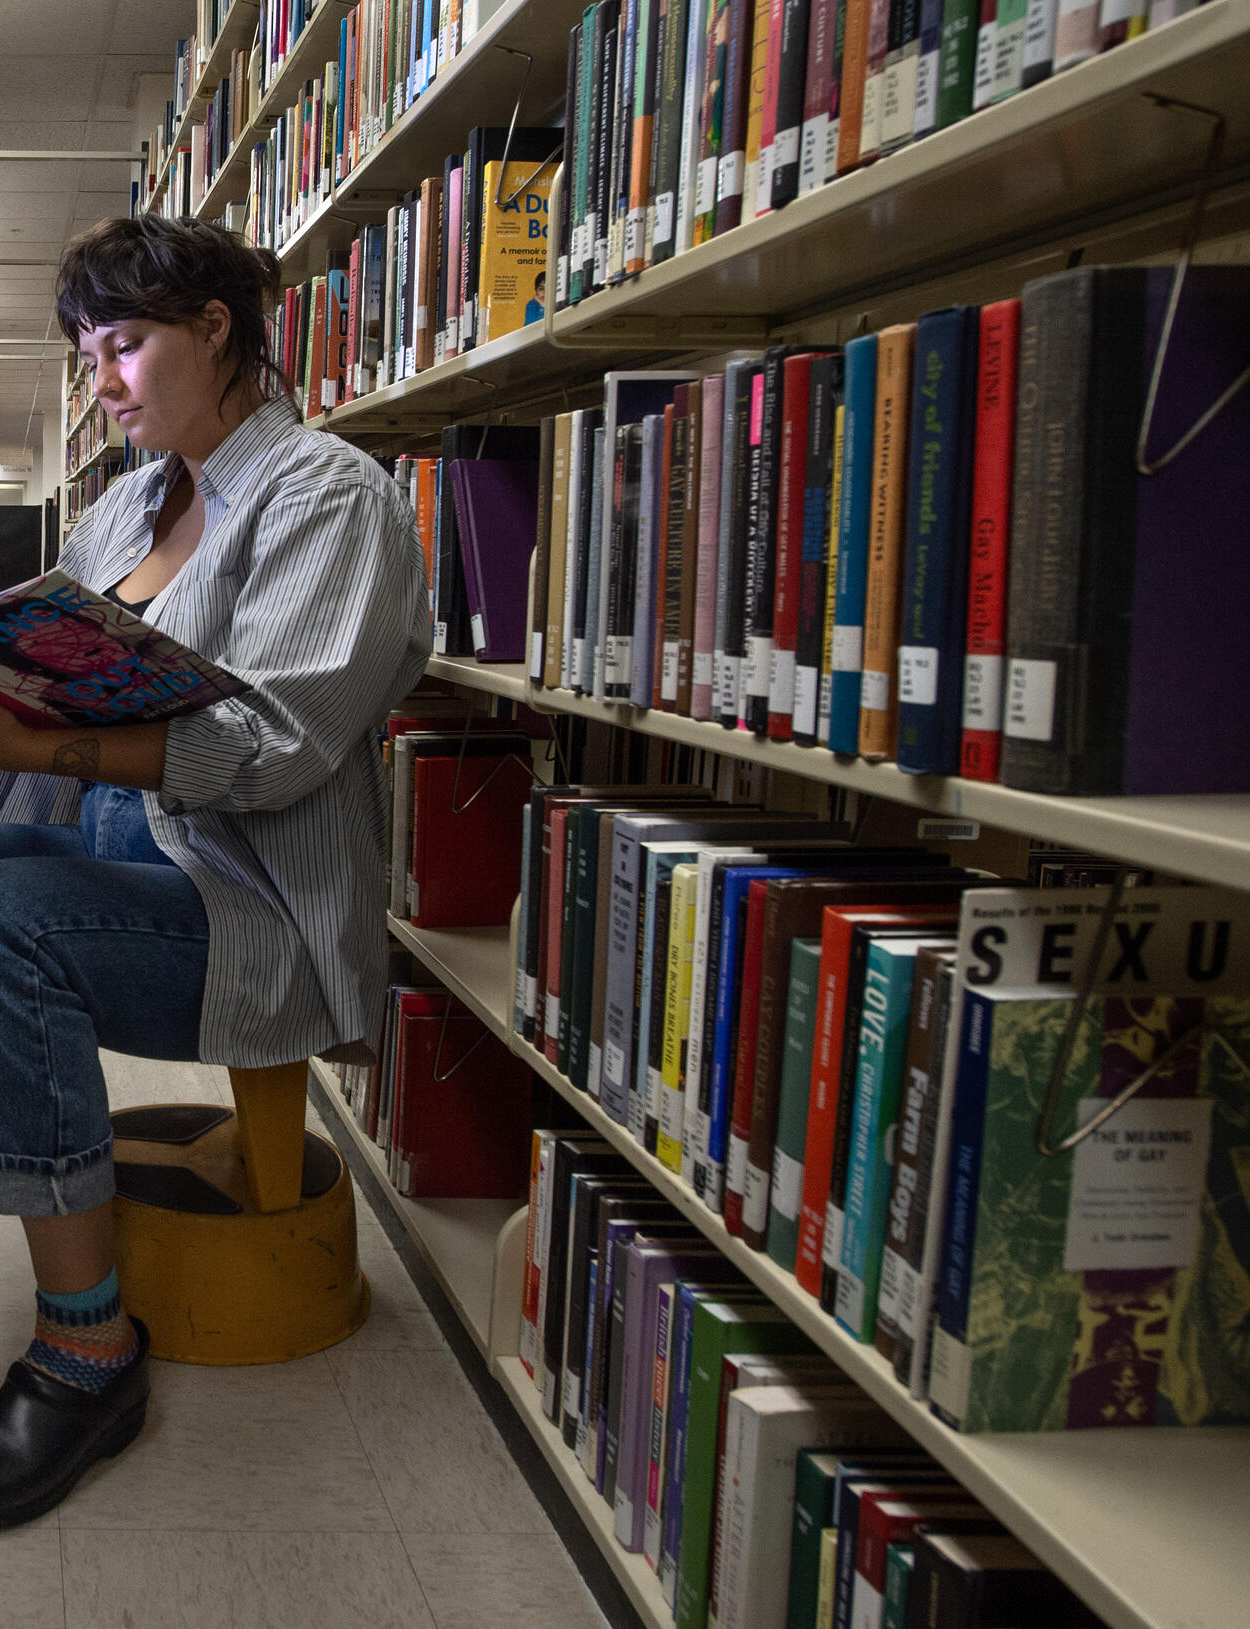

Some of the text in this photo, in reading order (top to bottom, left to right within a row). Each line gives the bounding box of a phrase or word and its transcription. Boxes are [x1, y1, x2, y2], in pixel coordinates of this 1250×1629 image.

[814, 8, 826, 64] CULTURE
[602, 59, 609, 70] IN
[602, 73, 608, 81] A
[622, 37, 631, 89] PALESTINE
[599, 83, 608, 129] DIFFERENT
[598, 131, 606, 168] CLIMATE
[502, 193, 521, 214] A
[596, 179, 604, 210] JEREMY
[400, 209, 409, 287] JIMMY NEUROSIS
[500, 247, 540, 255] A memoir
[517, 257, 534, 266] and
[920, 350, 944, 400] city
[983, 325, 1001, 411] LEVINE
[783, 420, 791, 436] THE
[924, 405, 942, 433] of
[754, 359, 778, 594] The Rise and Fall of Gay Culture
[781, 438, 791, 472] SOCIAL
[779, 474, 790, 519] ORGANIZATION
[873, 398, 893, 562] BEARING WITNESS
[917, 441, 941, 535] friends
[666, 463, 685, 592] GAY CULTURE IN
[778, 534, 788, 550] GAY
[779, 522, 788, 533] OF
[975, 518, 996, 560] Gay
[777, 551, 787, 577] MALES
[912, 545, 928, 600] LeVay
[970, 571, 992, 649] Macho
[65, 654, 155, 700] OUT
[82, 670, 200, 724] LOUD
[669, 944, 680, 968] DRY
[708, 929, 719, 960] THEN
[665, 970, 680, 1012] BONES
[761, 975, 776, 1019] GAY
[916, 976, 935, 1031] Fellows
[663, 1012, 679, 1068] BREATHE
[688, 1037, 699, 1074] men
[854, 1060, 875, 1161] CHRISTOPHER
[888, 1065, 929, 1245] Farm Boys
[1092, 1129, 1193, 1144] THE MEANING
[1113, 1150, 1165, 1162] OF GAY
[849, 1165, 865, 1220] STREET
[947, 1145, 971, 1299] THE MEANING OF GAY
[648, 1303, 669, 1462] British queer history
